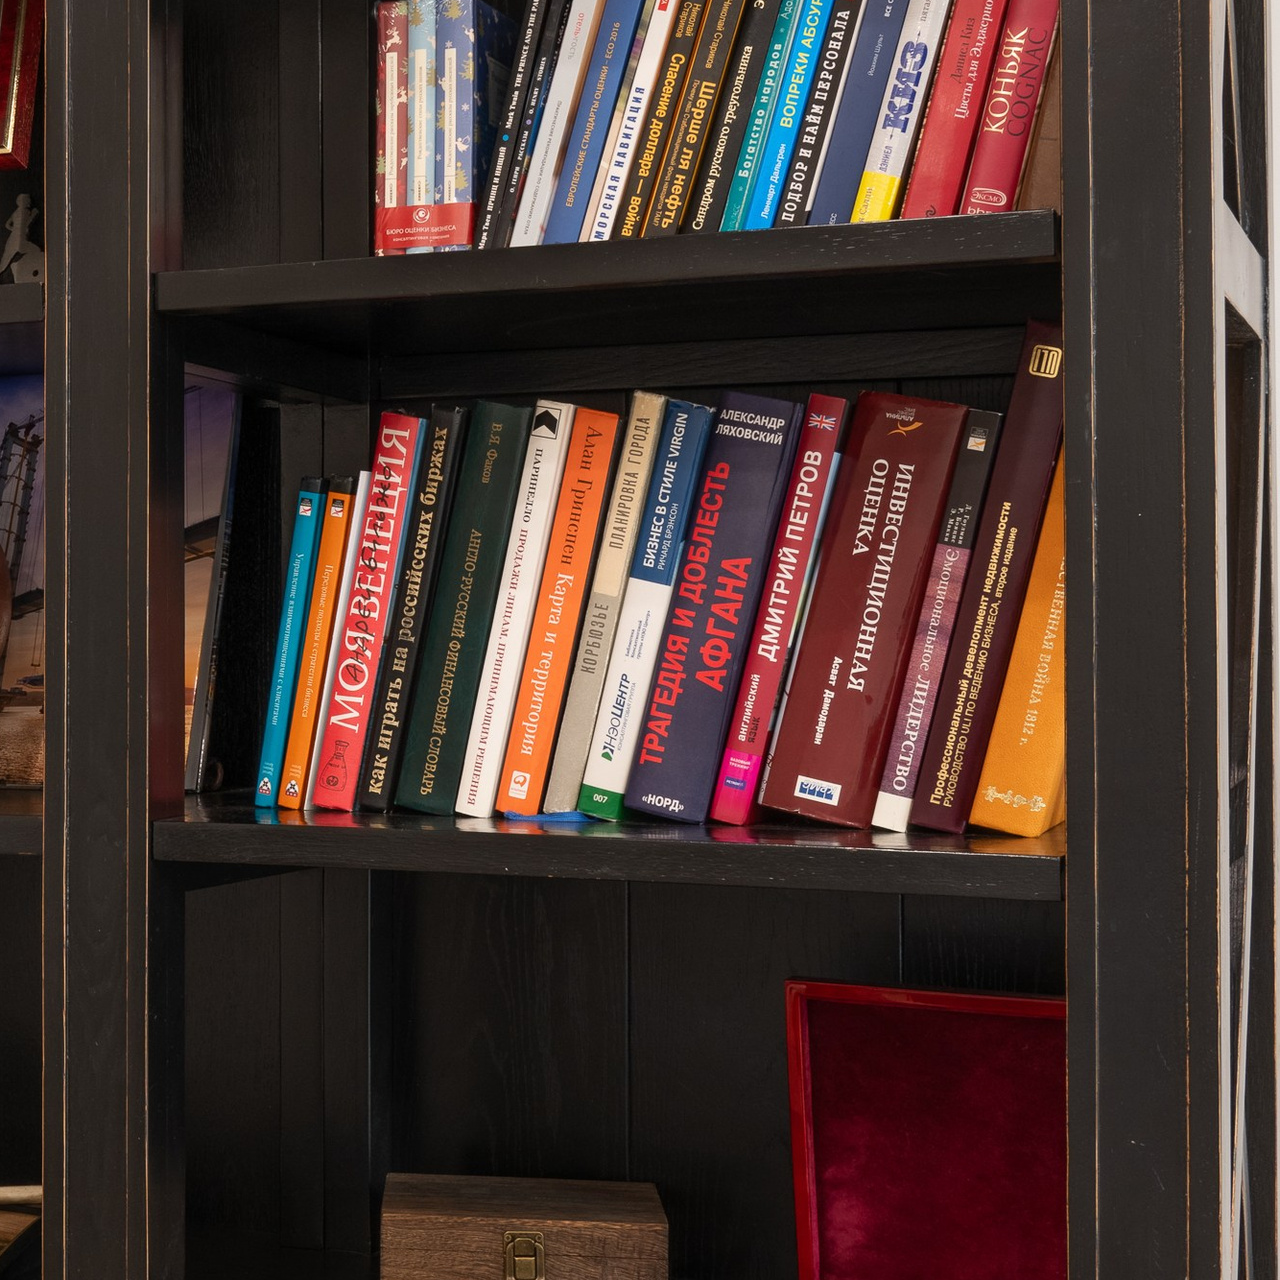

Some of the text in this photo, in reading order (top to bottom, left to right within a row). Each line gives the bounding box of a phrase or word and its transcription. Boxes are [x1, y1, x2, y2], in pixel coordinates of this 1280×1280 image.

[566, 65, 610, 207] ЕВРОПЕЙСКИЕ СТАНДАРТЫ ОЦЕНКИ
[622, 52, 686, 238] Спасение доллара война
[691, 46, 753, 230] Синдром русского треугольника
[738, 42, 783, 179] Богатство народов
[778, 50, 810, 128] ВОПРЕКИ
[782, 11, 850, 223] ПОДБОР И НАЙМ ПЕРСОНАЛА
[882, 41, 928, 134] КИЗ
[985, 28, 1028, 133] КОНЬЯК
[1007, 27, 1048, 138] COGNAC
[593, 86, 646, 241] МОРСКАЯ НАВИГАЦИЯ
[662, 82, 716, 228] Шерше ля нефть
[524, 449, 543, 522] ПАРИНЕЛЛО
[609, 418, 650, 549] ПЛАНИРОВКА ГОРОДА
[643, 412, 688, 567] БИЗНЕС В СТИЛЕ VIRGIN
[715, 422, 783, 445] ЛЯХОВСКИЙ
[720, 408, 785, 429] АЛЕКСАНДР
[561, 426, 601, 564] Алан Гринспен
[757, 448, 821, 662] ДМИТРИЙ ПЕТРОВ
[851, 458, 889, 557] ОЦЕНКА
[329, 426, 410, 733] МОЯ ВЕНЕЦИЯ
[581, 603, 608, 674] КОРБЮЗЬЕ
[640, 459, 733, 764] ТРАГЕДИЯ И ДОБЛЕСТЬ
[698, 552, 754, 692] АФГАНА
[847, 463, 916, 694] ИНВЕСТИЦИОННАЯ
[420, 529, 482, 795] АНГЛО-РУССКИЙ ФИНАНСОВЫЙ СЛОВАРЬ
[521, 574, 573, 755] Карта и территория
[891, 548, 960, 794] Эмоциональное ЛИДЕРСТВО
[930, 501, 1012, 805] Профессиональный девелопмент недвижимости
[641, 793, 685, 813] «НОРД»
